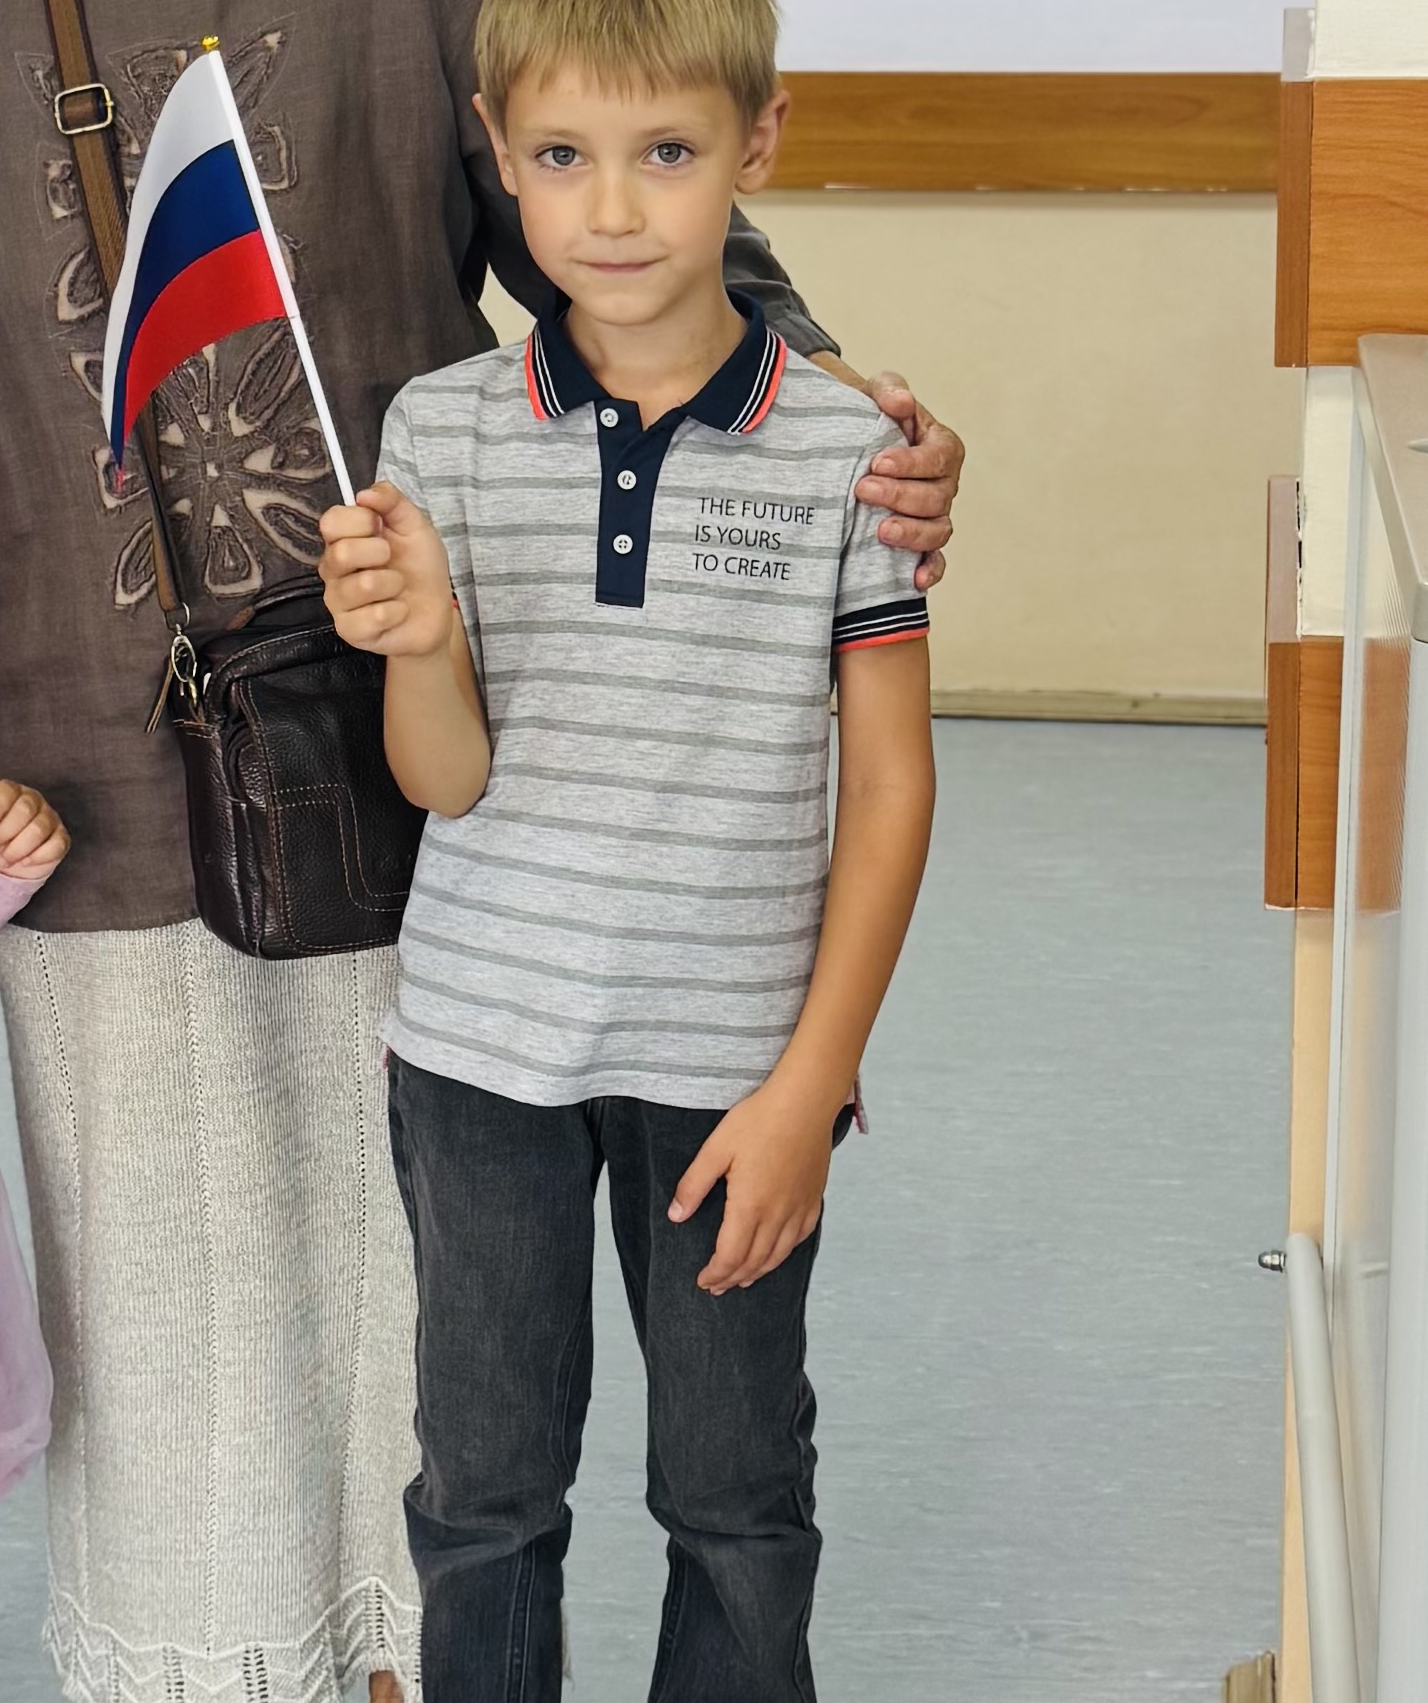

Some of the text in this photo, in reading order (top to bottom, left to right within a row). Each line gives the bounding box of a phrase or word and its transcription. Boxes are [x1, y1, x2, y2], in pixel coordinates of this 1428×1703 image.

[697, 497, 815, 525] THE FUTURE
[695, 524, 781, 551] IS YOURS
[692, 552, 791, 581] TO CREATE
